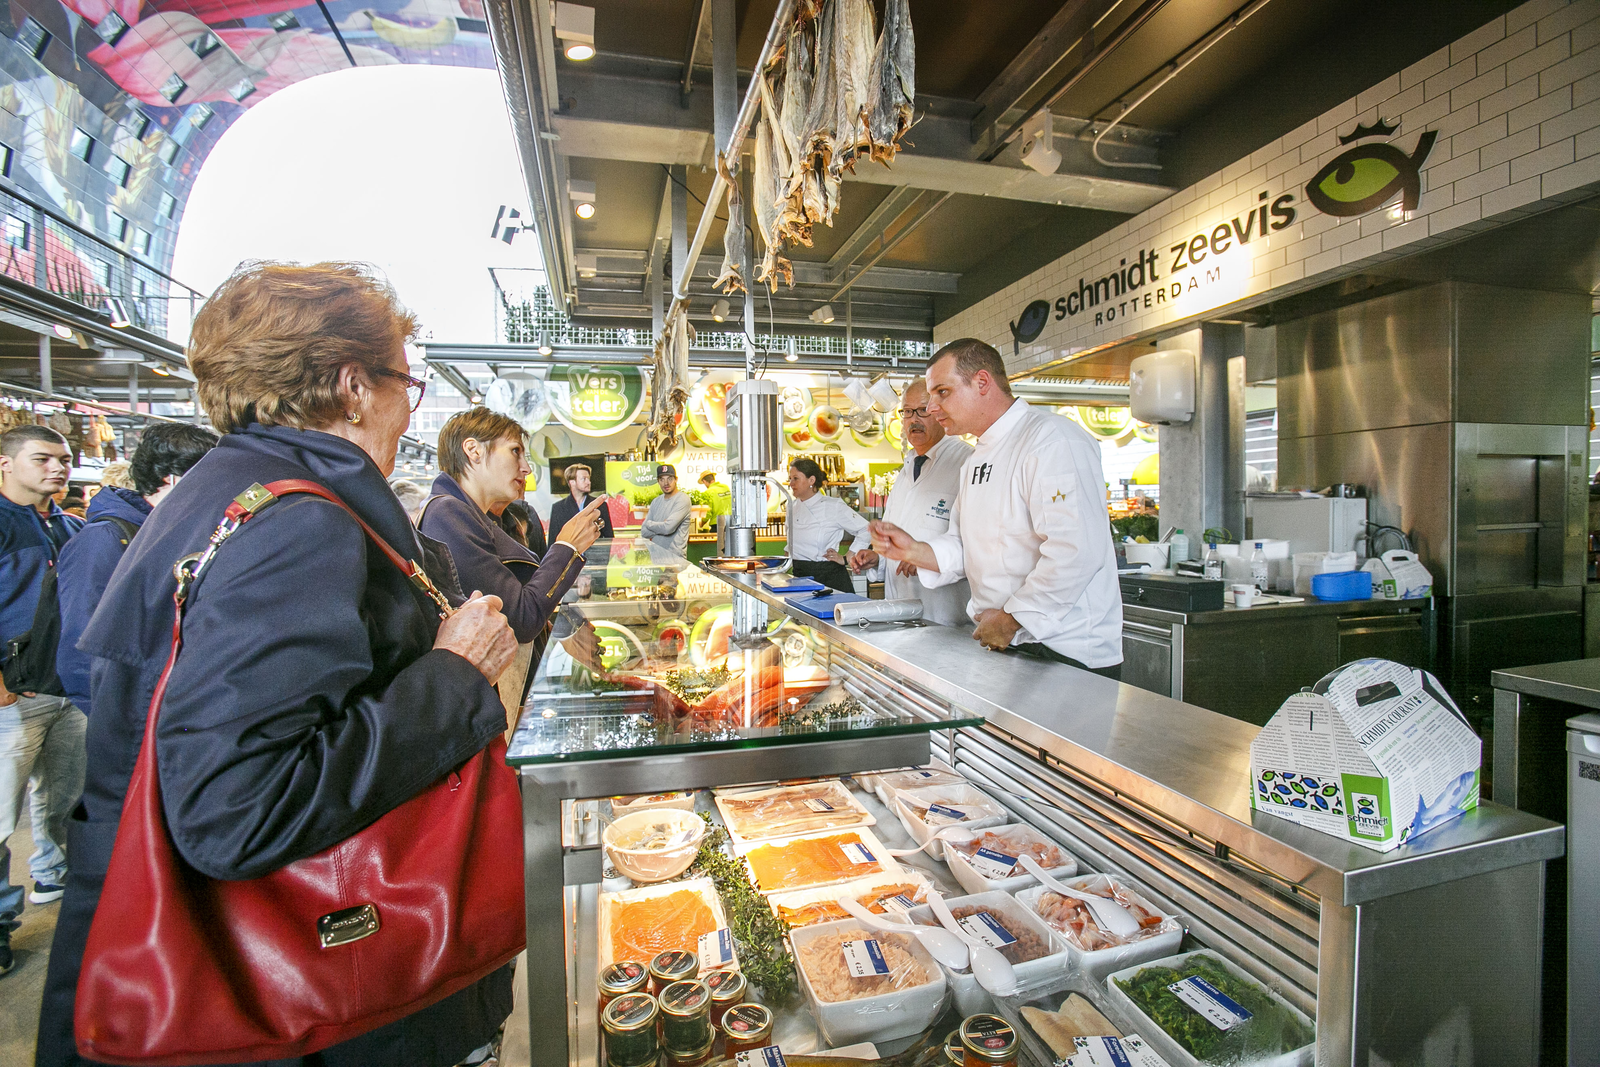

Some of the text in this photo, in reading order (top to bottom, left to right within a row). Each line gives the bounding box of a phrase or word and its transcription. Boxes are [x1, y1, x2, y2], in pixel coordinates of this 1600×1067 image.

[1055, 191, 1296, 320] schmidt zeevis
[1095, 266, 1221, 326] ROTTERDAM
[576, 373, 617, 389] Vers
[573, 395, 621, 413] teler
[636, 464, 652, 476] Tijd
[1347, 814, 1388, 826] schmidt
[1193, 975, 1220, 996] Wakame
